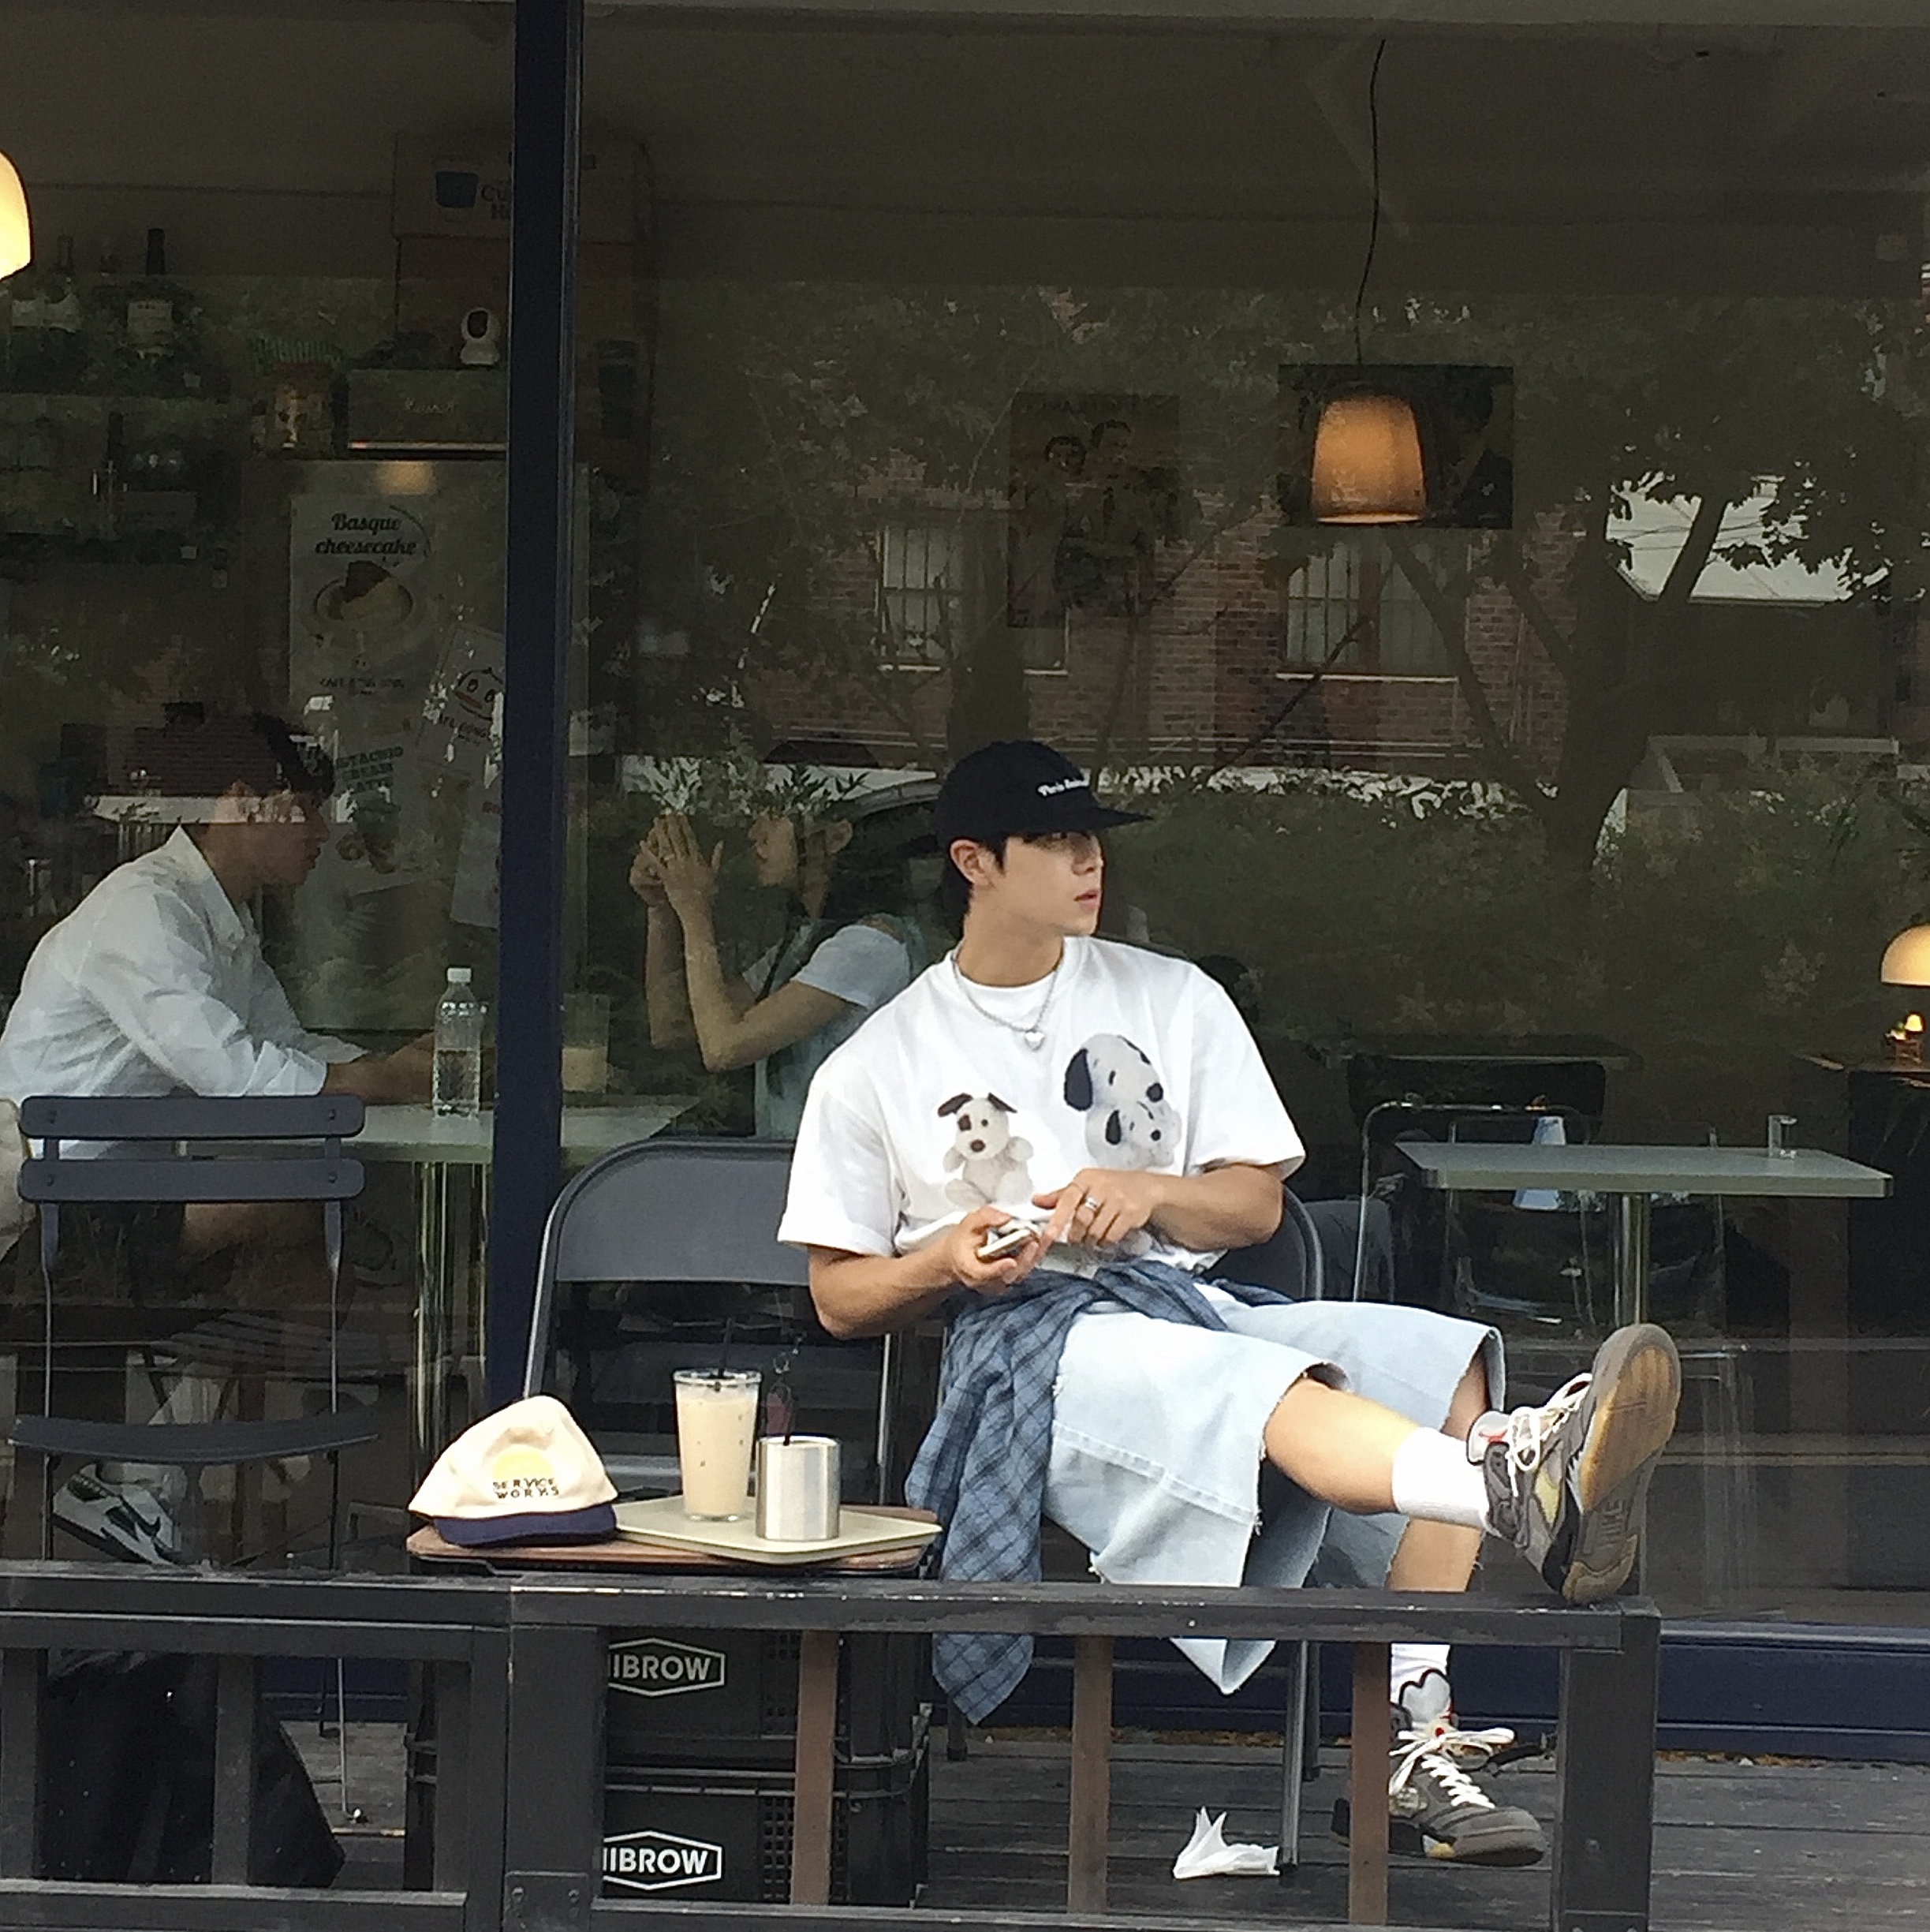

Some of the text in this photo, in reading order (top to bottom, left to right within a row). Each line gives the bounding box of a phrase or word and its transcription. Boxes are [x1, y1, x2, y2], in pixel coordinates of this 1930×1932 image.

[331, 513, 402, 535] Basque
[315, 537, 417, 555] cheesecake
[494, 1485, 559, 1499] WORKS
[607, 1654, 712, 1681] IBROW
